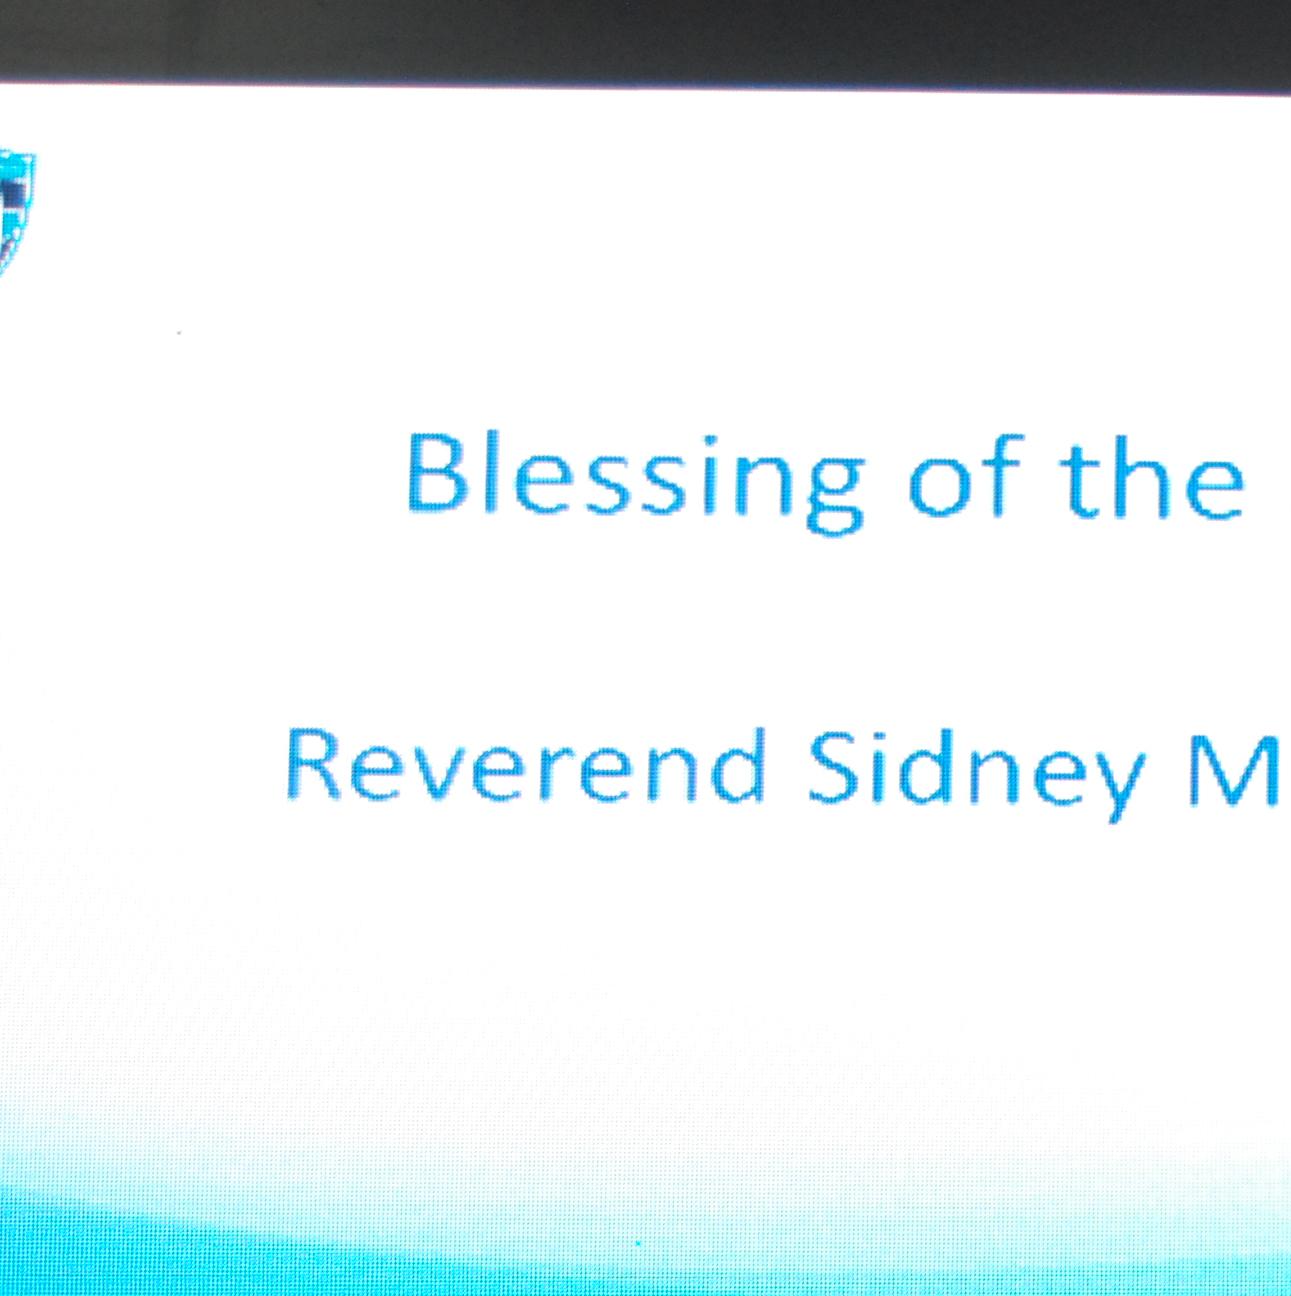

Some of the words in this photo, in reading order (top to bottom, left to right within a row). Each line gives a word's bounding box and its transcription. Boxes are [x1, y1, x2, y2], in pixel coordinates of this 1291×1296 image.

[407, 429, 867, 538] Blessing
[908, 433, 1026, 519] of
[1058, 434, 1245, 521] the
[286, 726, 766, 804] Reverend
[808, 727, 1148, 825] Sidney
